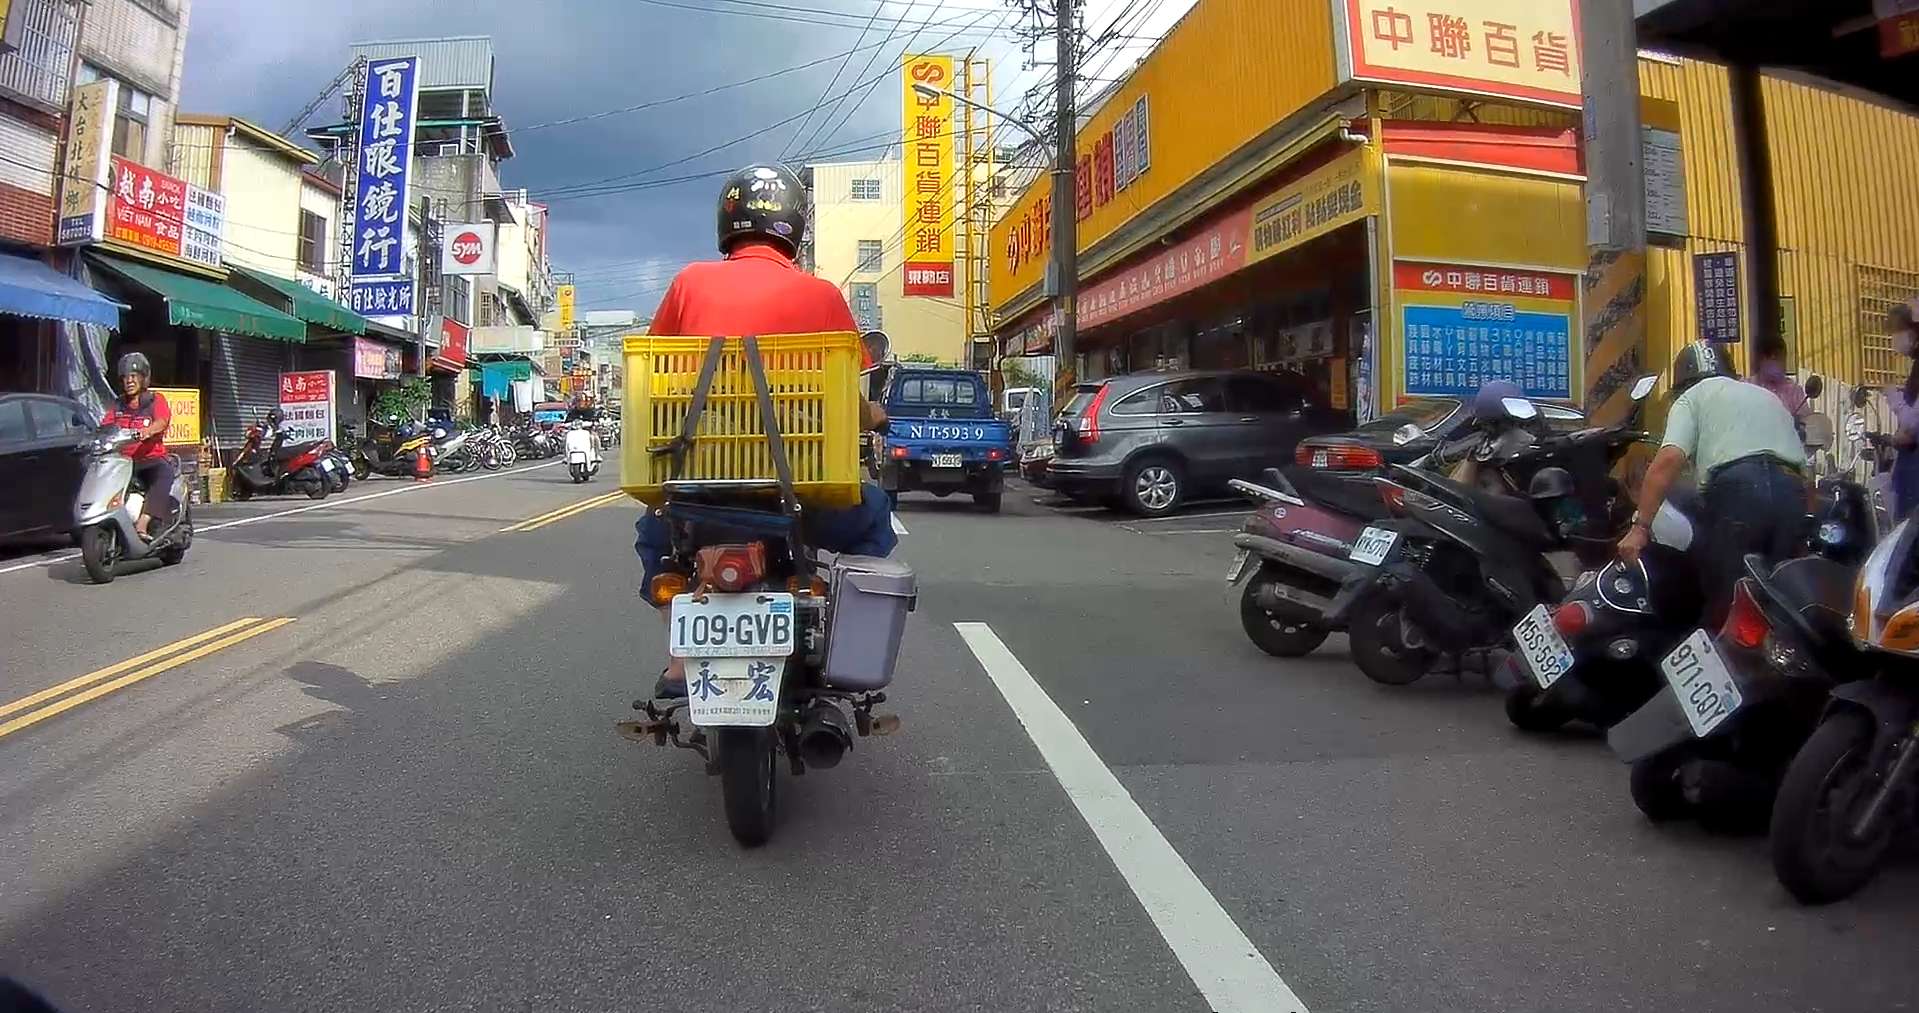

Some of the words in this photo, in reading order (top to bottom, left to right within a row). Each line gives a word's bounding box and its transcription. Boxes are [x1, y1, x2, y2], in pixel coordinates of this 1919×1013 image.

[1371, 6, 1571, 77] 中聯百貨
[357, 60, 410, 269] 百仕眼鏡行
[915, 90, 942, 253] 中聯百貨連鎖
[119, 166, 156, 210] 越南
[154, 220, 180, 240] 食品
[452, 242, 482, 257] SYM
[352, 287, 412, 311] 百仕驗光所
[1447, 271, 1550, 296] 中聯百貨連鎖
[677, 614, 790, 646] 109-GVB
[1515, 609, 1562, 684] M5S-592
[1668, 641, 1727, 726] 971-CQY
